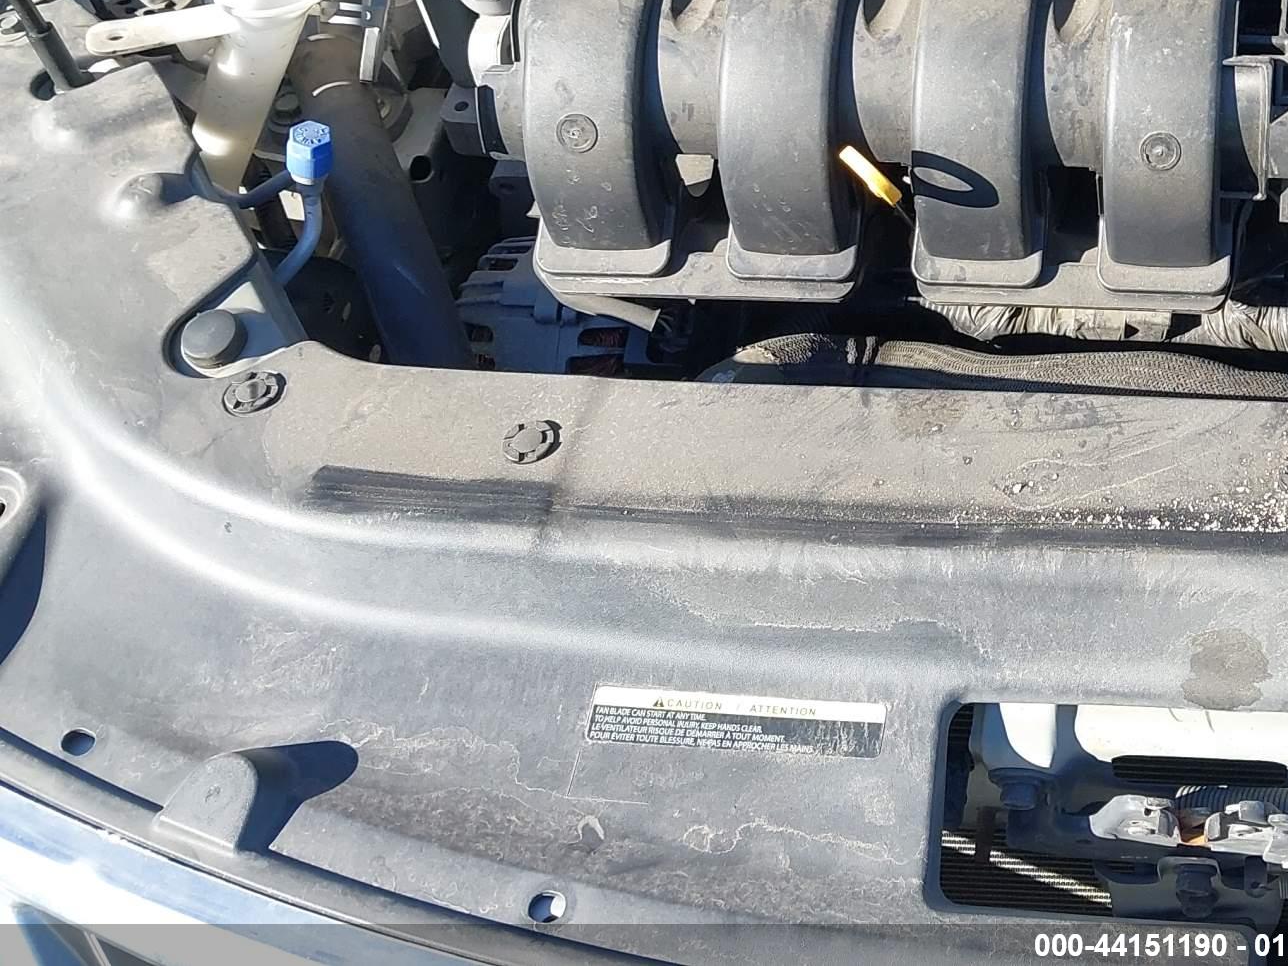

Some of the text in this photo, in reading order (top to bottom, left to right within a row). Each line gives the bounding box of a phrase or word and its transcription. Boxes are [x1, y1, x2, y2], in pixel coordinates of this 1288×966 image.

[610, 707, 631, 716] BLADE
[631, 709, 645, 717] CAN
[646, 710, 666, 718] START
[666, 711, 674, 719] AT
[675, 712, 690, 720] ANY
[667, 699, 722, 710] CAUTION
[749, 705, 817, 716] ATTENTION
[591, 723, 601, 731] LE
[601, 724, 647, 734] VENTILATEUR
[647, 727, 674, 736] RISQUE
[674, 729, 685, 737] DE
[731, 733, 751, 741] TOUT
[594, 714, 603, 722] TO
[604, 715, 621, 724] HELP
[622, 717, 642, 725] AVOID
[642, 719, 676, 728] PERSONAL
[700, 721, 717, 730] KEEP
[717, 723, 740, 732] HANDS
[589, 731, 610, 740] POUR
[636, 735, 659, 743] TOUTE
[722, 741, 733, 749] EN
[733, 742, 775, 751] APPROCHER
[776, 744, 788, 752] LES
